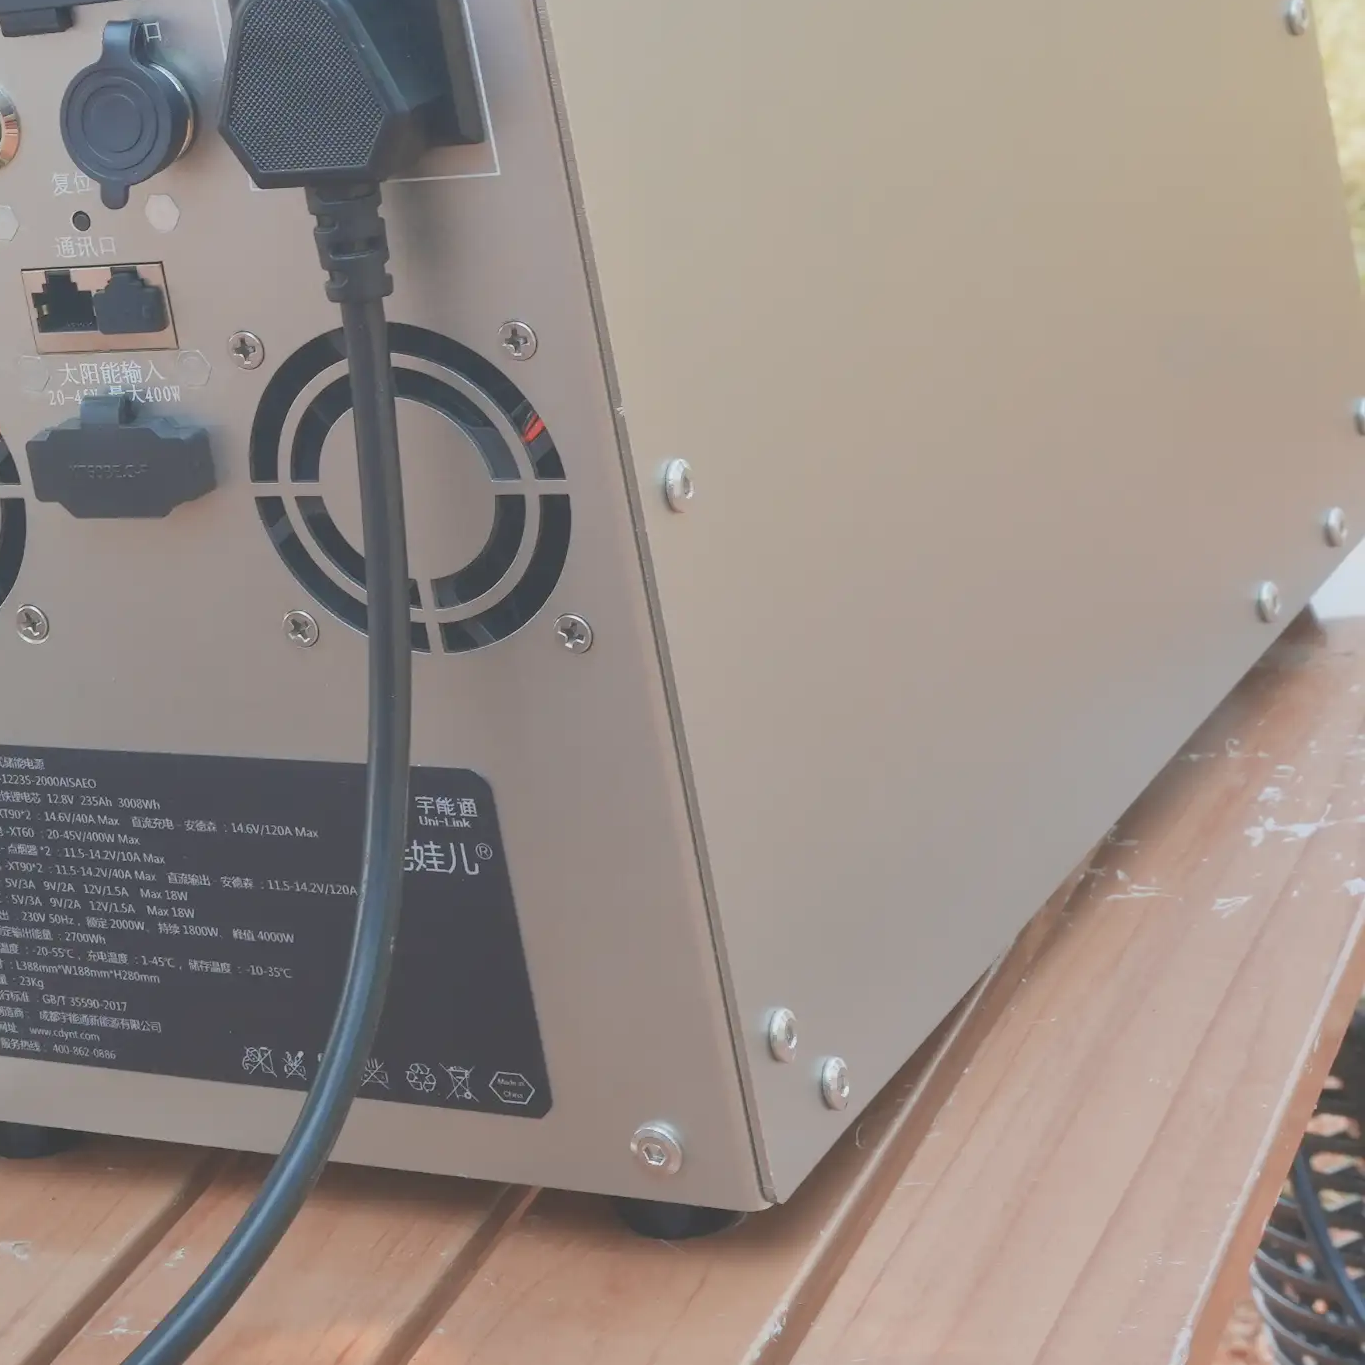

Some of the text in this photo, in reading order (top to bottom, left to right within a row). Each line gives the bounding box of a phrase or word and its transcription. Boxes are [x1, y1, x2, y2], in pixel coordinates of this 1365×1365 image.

[50, 173, 93, 196] 复位
[53, 236, 117, 259] 通讯口
[58, 360, 167, 387] 太阳能输入
[46, 793, 73, 804] 12.8V
[79, 795, 112, 806] 235Ah
[117, 797, 160, 809] 3008Wh
[414, 795, 478, 818] 宇能通
[96, 814, 119, 825] Max
[294, 826, 318, 837] Max
[418, 815, 472, 828] Uni-Link
[117, 833, 140, 845] Max
[142, 852, 165, 863] Max
[134, 869, 156, 881] Max
[4, 877, 35, 889] 5V/3A
[42, 880, 75, 892] 9V/2A
[83, 883, 129, 897] 12V/1.5A
[139, 887, 162, 898] Max
[164, 889, 187, 901] 18W
[10, 893, 42, 906] 5V/3A
[49, 897, 81, 909] 9V/2A
[88, 900, 135, 913] 12V/1.5A
[146, 904, 169, 916] Max
[170, 906, 194, 918] 18W
[21, 910, 45, 922] 230V
[256, 930, 294, 943] 4000W
[64, 931, 106, 944] 2700Wh
[18, 975, 44, 990] 23Kg
